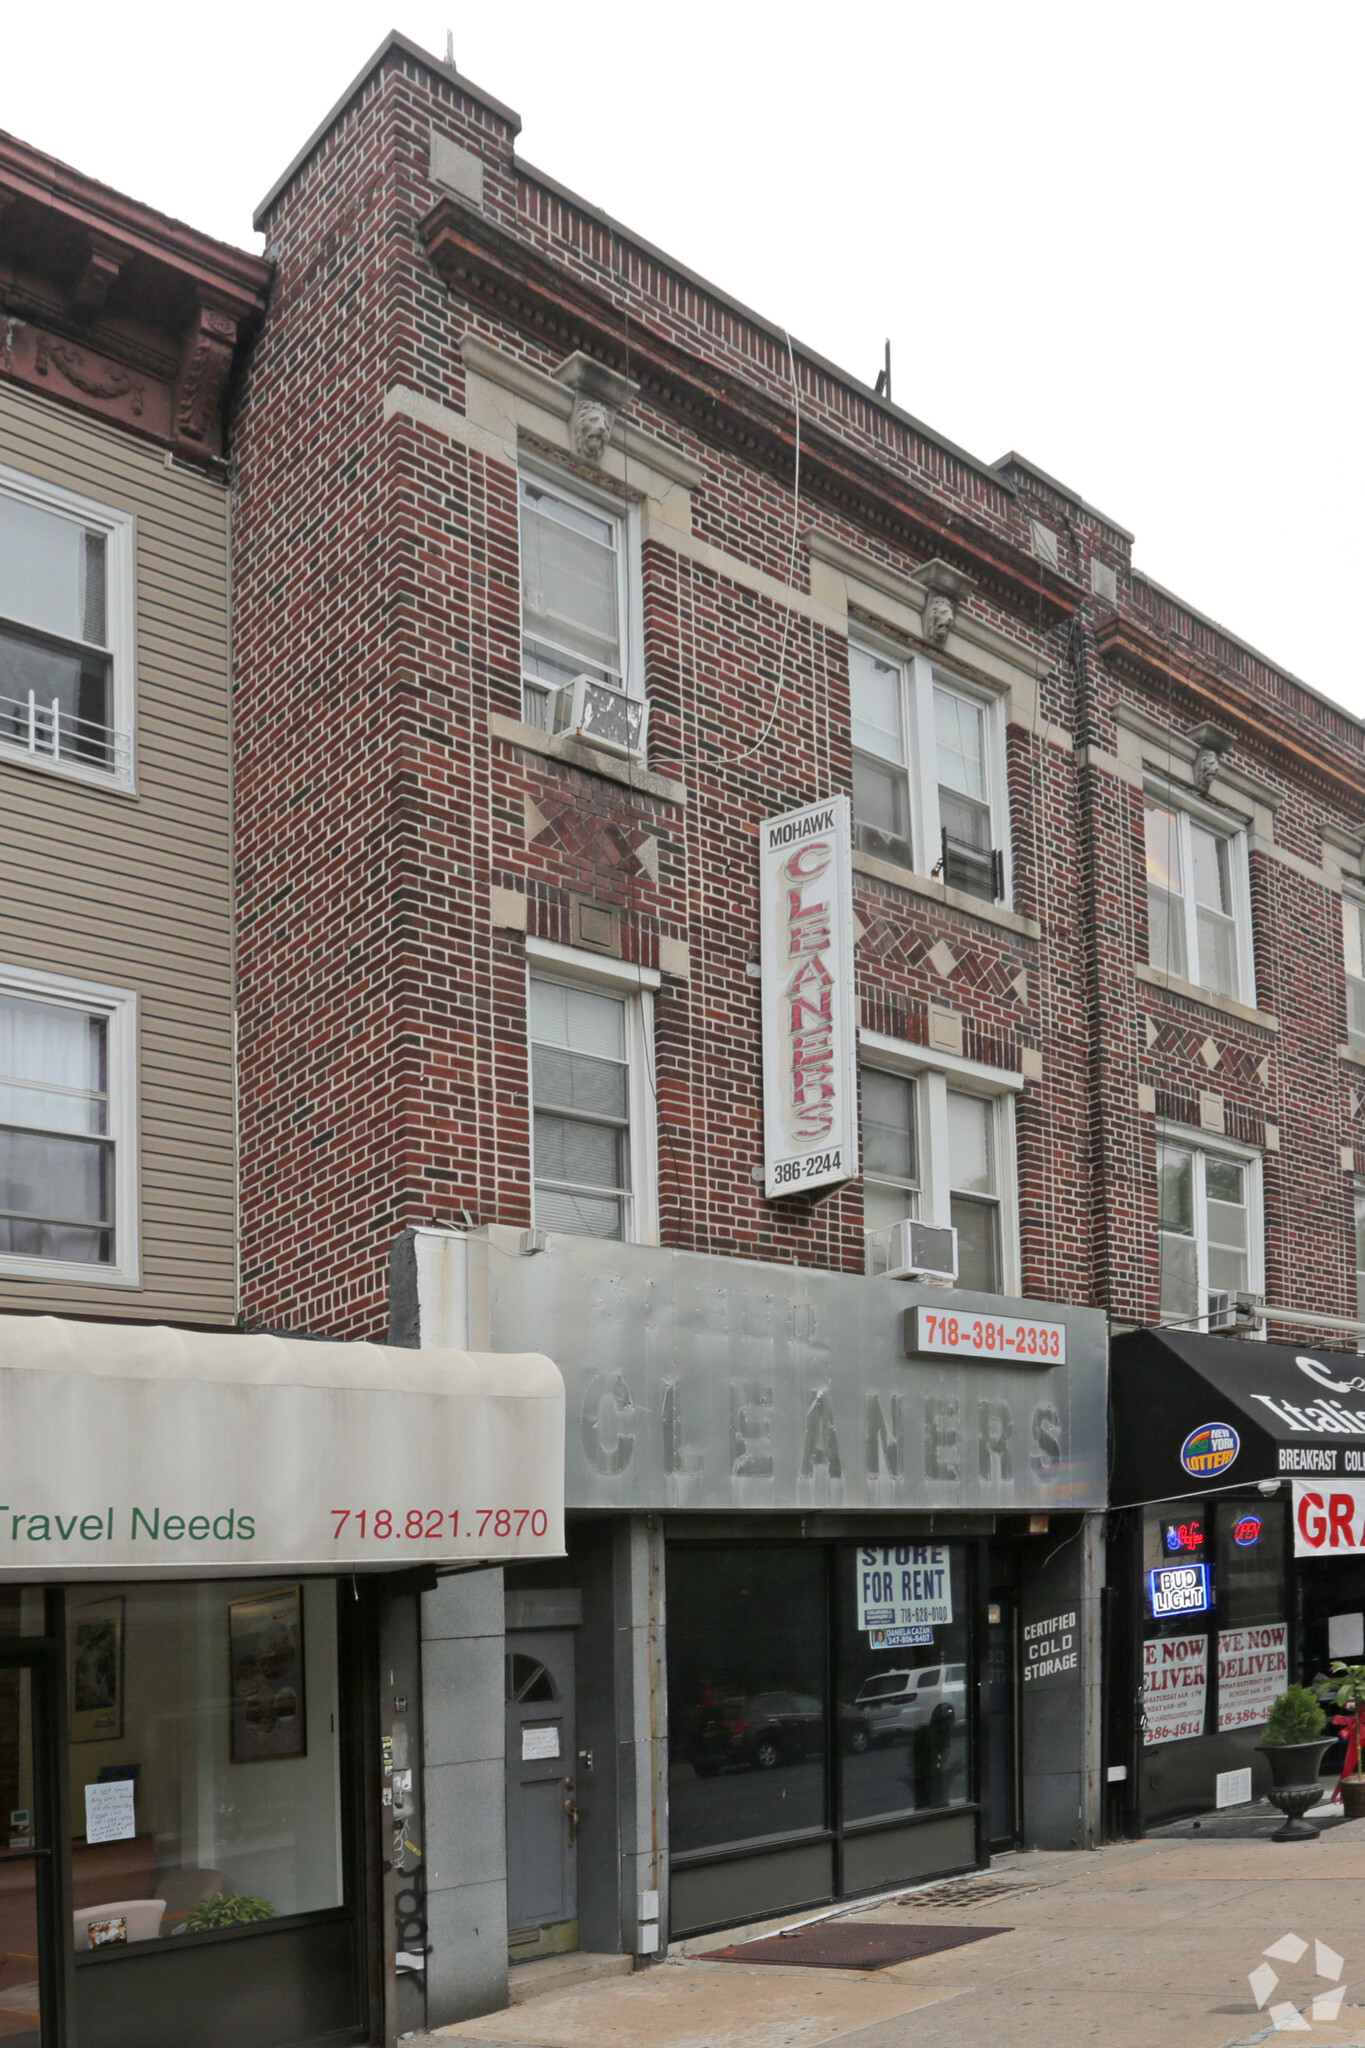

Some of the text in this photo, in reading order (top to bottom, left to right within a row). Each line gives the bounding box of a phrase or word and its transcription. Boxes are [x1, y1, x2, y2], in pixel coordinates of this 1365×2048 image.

[770, 808, 835, 849] MOHAWK
[785, 842, 835, 1142] CLEANERS
[774, 1150, 842, 1184] 386-2244
[925, 1315, 1060, 1358] 718-381-2333
[1211, 1429, 1230, 1439] NEW
[1211, 1438, 1234, 1451] YORK
[1186, 1449, 1235, 1471] LOTTERY
[1279, 1449, 1365, 1471] BREAKFAST COL
[0, 1507, 256, 1541] ravel Needs
[330, 1509, 549, 1540] 718.821.7870
[1234, 1522, 1263, 1541] OPEN
[1298, 1492, 1365, 1549] GR
[862, 1545, 944, 1567] STORE
[863, 1569, 945, 1604] FOR RENT
[1161, 1569, 1197, 1592] BUD
[1155, 1586, 1204, 1612] LIGHT
[886, 1628, 911, 1637] DANIELA
[1024, 1611, 1076, 1641] CERTIFIED
[1028, 1634, 1073, 1660] COLD
[1143, 1639, 1205, 1666] E NOW
[1218, 1627, 1286, 1654] WE NOW
[1024, 1652, 1078, 1681] STORAGE
[1143, 1665, 1205, 1693] ELIVER
